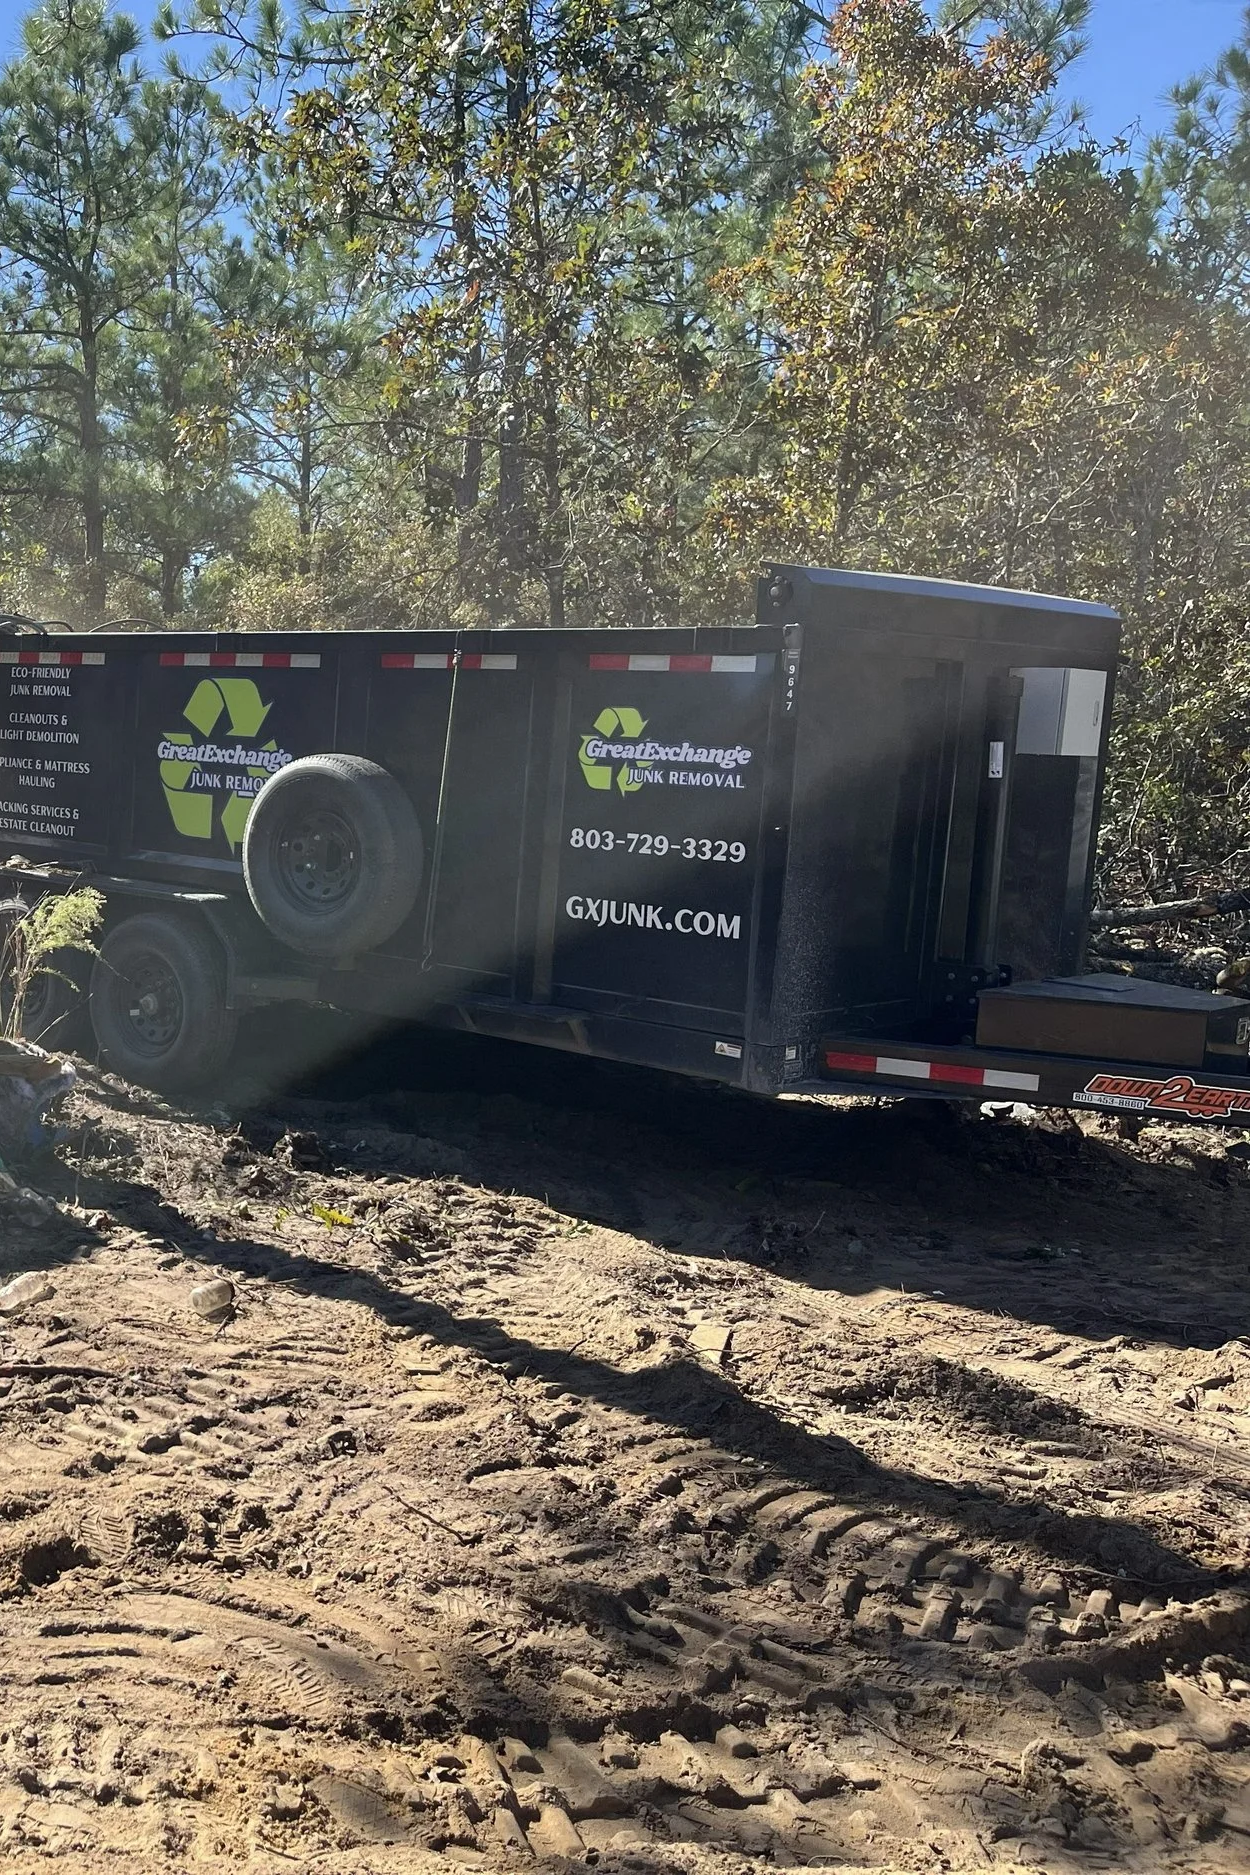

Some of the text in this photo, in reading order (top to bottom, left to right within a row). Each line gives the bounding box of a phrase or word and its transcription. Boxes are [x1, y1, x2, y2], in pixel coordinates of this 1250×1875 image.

[11, 666, 72, 679] ECO-FRIENDLY
[10, 684, 72, 697] JUNK REMOVAL
[9, 712, 68, 726] CLEANOUTS &
[0, 729, 80, 744] LIGHT DEMOLITION
[157, 741, 293, 772] GreatExchange
[586, 739, 752, 769] GreatExchange
[35, 759, 42, 770] &
[44, 760, 90, 774] MATTRESS
[18, 774, 55, 788] HAULING
[190, 769, 269, 792] JUNK REMO
[627, 769, 745, 789] JUNK REMOVAL
[30, 804, 71, 819] SERVICES
[72, 808, 79, 820] &
[29, 821, 75, 837] CLEANOUT
[569, 827, 746, 863] 803-729-3329
[565, 895, 741, 940] GXJUNK.COM
